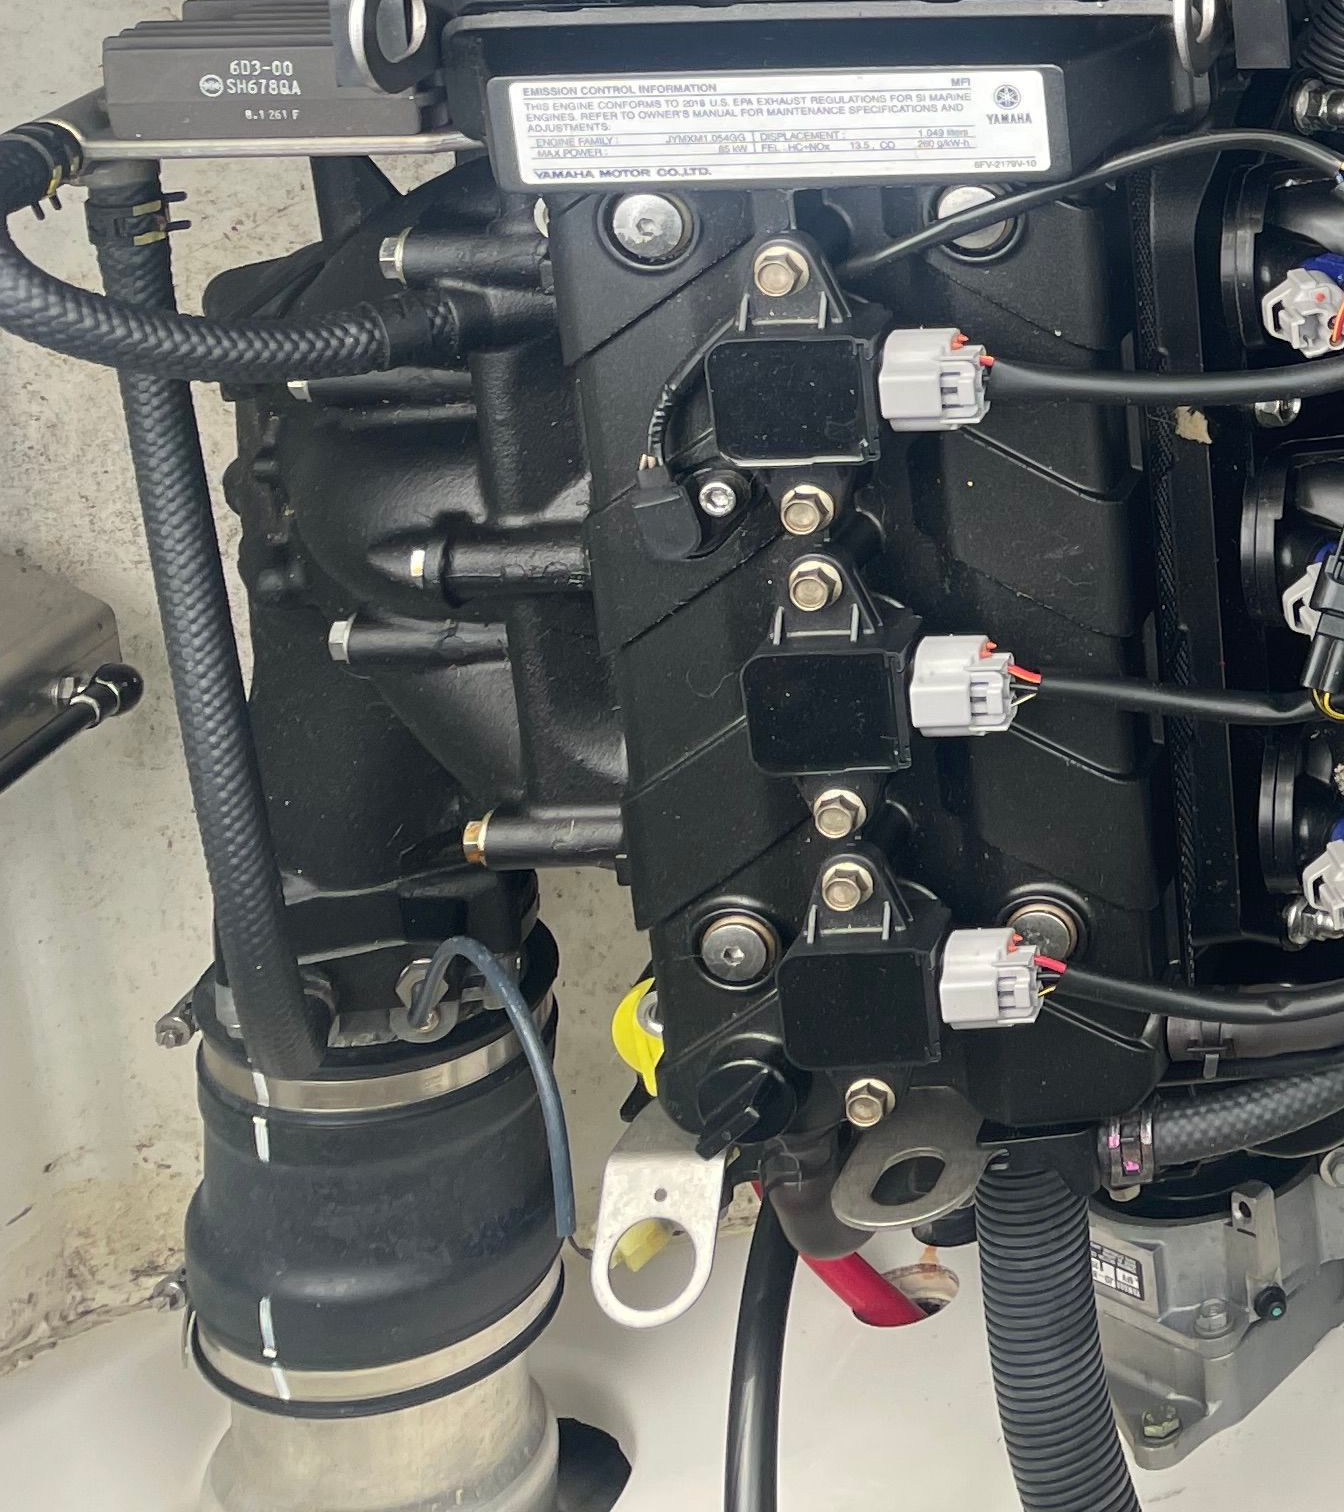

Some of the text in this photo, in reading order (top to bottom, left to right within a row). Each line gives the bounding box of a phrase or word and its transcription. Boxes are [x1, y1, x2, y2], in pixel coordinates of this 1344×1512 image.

[523, 83, 717, 96] EMISSION CONTROL INFORMATION
[525, 103, 549, 111] THIS
[553, 102, 594, 111] ENGINE
[598, 100, 661, 110] CONFORMS
[665, 100, 679, 108] TO
[734, 98, 753, 106] EPA
[757, 96, 808, 105] EXHAUST
[811, 94, 886, 104] REGULATIONS
[890, 94, 912, 103] FOR
[929, 92, 971, 102] MARINE
[581, 112, 618, 121] REFER
[621, 111, 635, 120] TO
[693, 109, 738, 118] MANUAL
[741, 108, 764, 117] FOR
[767, 107, 846, 116] MAINTENANCE
[850, 105, 938, 114] SPECIFICATIONS
[941, 104, 963, 112] AND
[986, 113, 1032, 124] YAMAHA
[535, 170, 594, 179] YAMAHA
[600, 170, 650, 178] MOTOR
